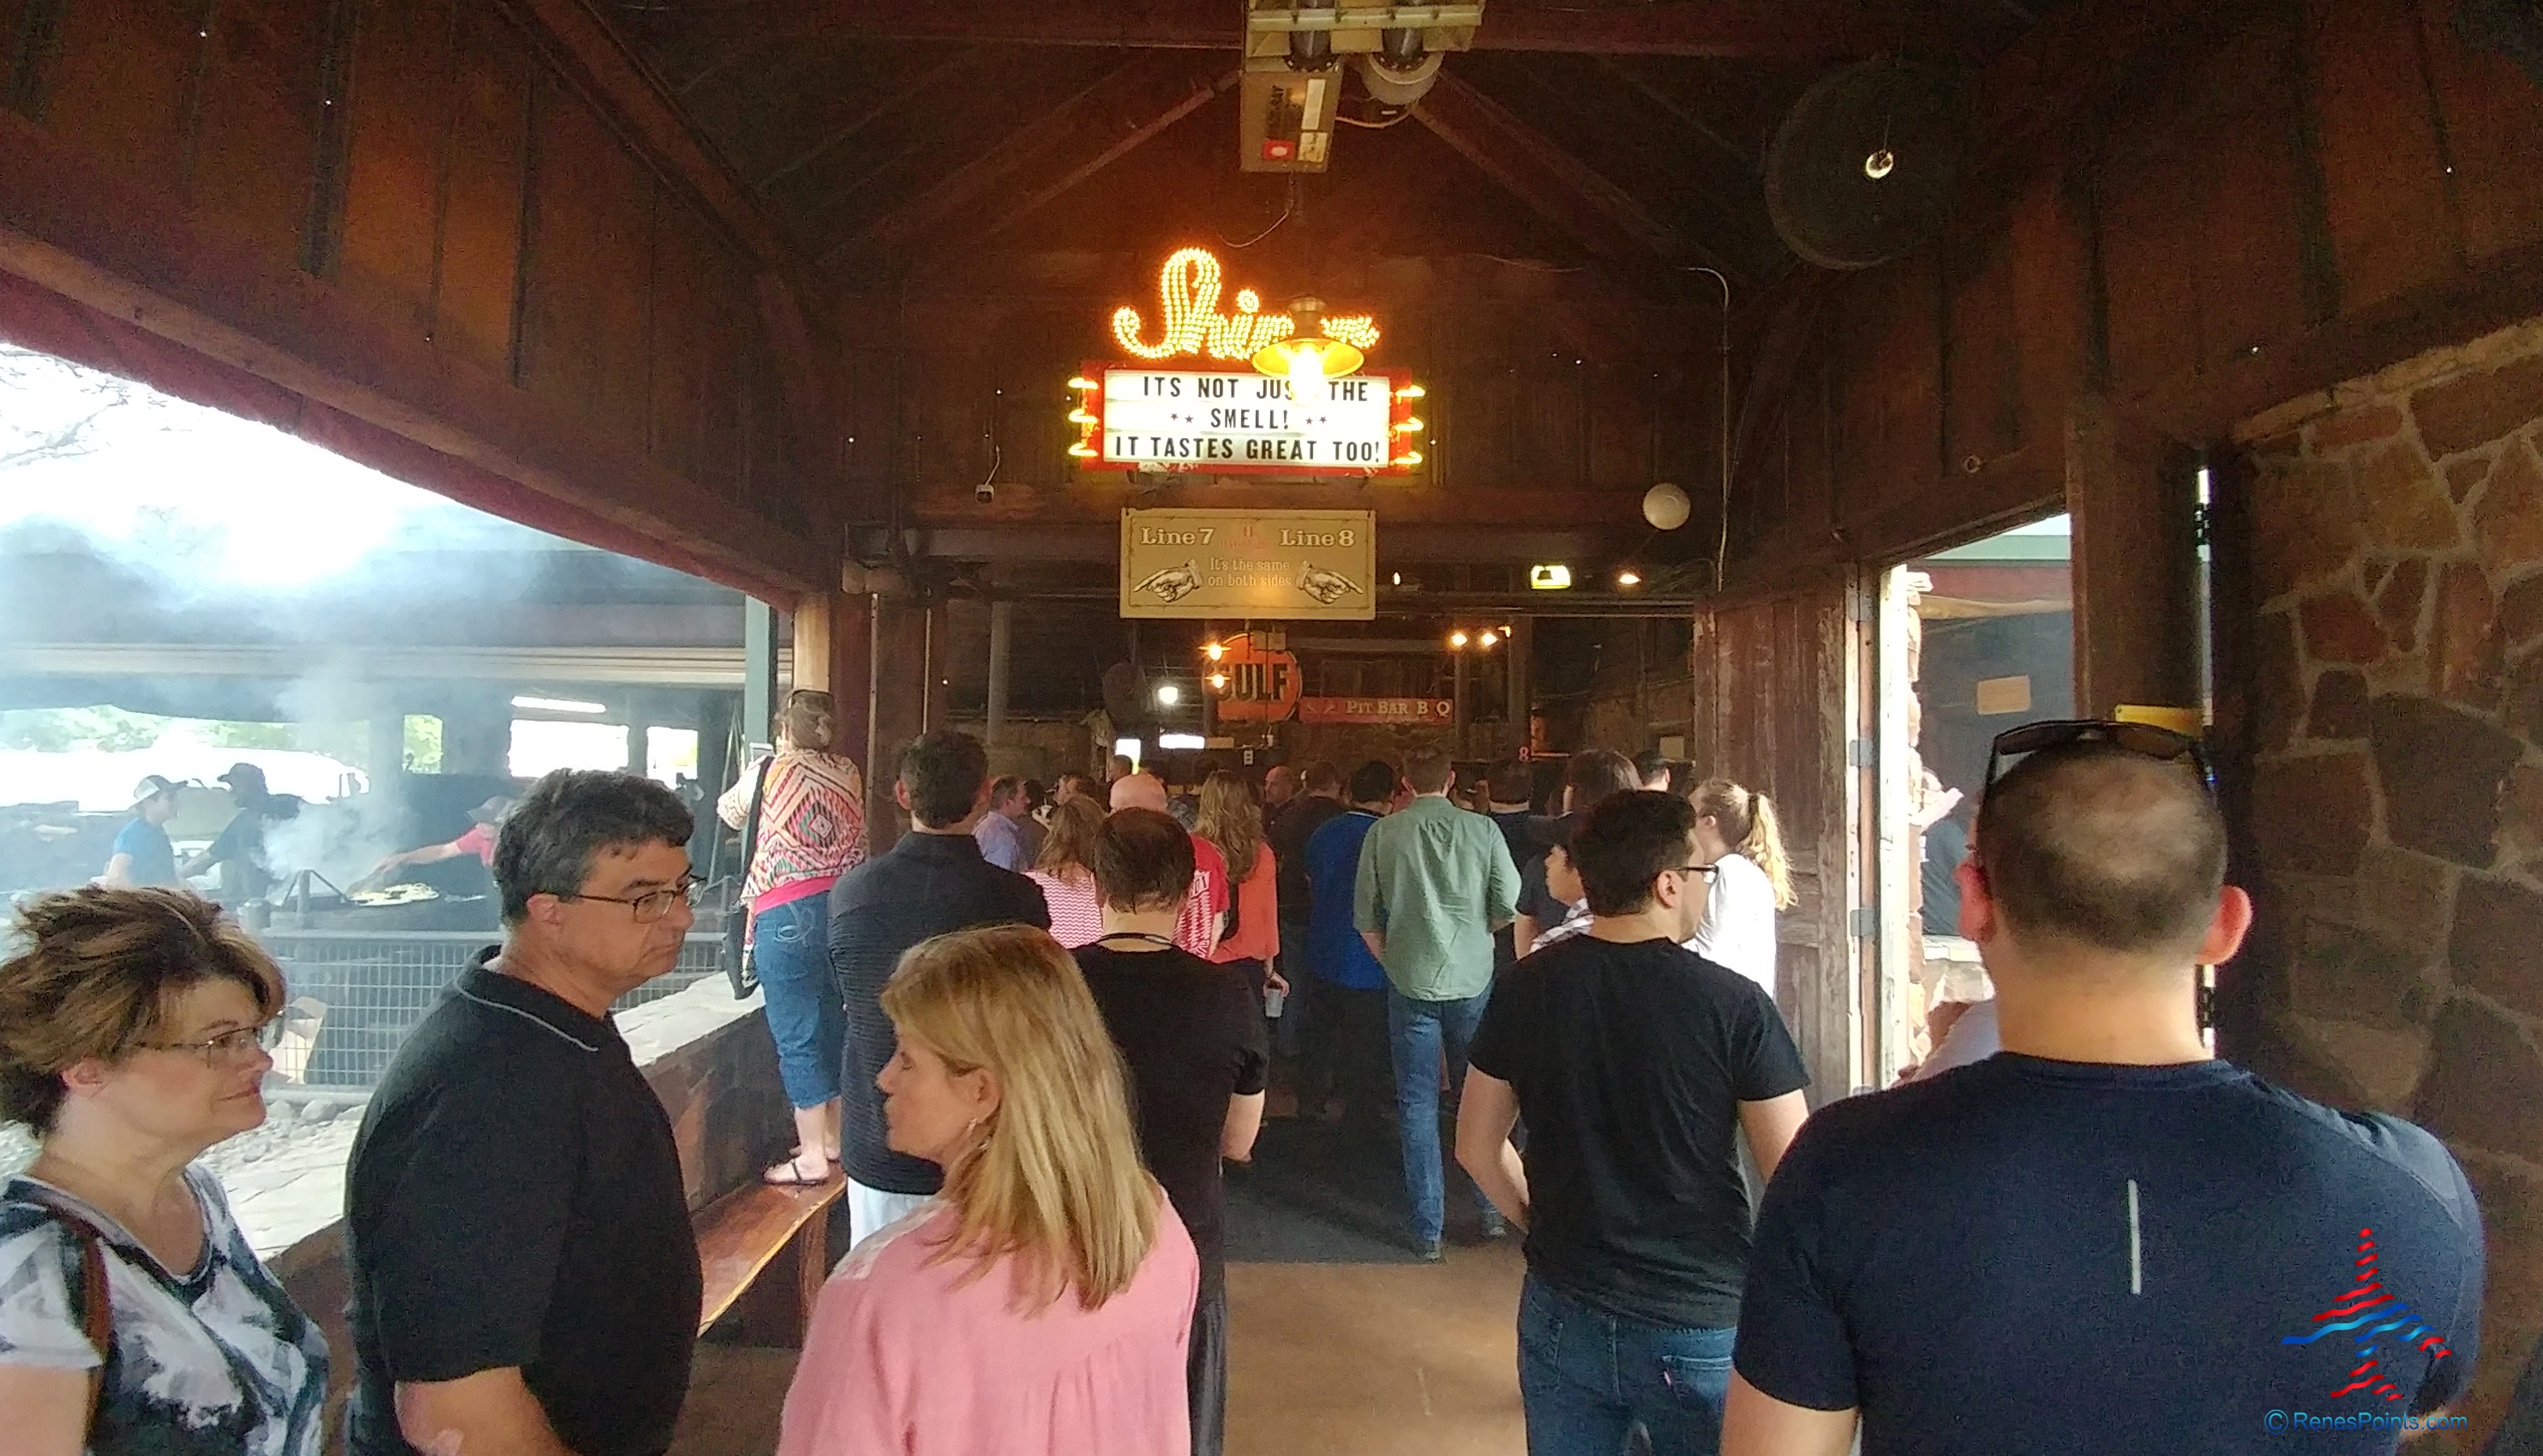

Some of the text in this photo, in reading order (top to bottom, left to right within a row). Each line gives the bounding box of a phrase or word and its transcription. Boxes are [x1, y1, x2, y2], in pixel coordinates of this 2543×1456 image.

[1144, 376, 1368, 401] ITS NOT JUS THE
[1211, 408, 1289, 429] SMELL!
[1116, 436, 1380, 463] IT TASTES GREAT TOO!
[1140, 527, 1196, 545] Line
[1198, 528, 1215, 545] 7
[1279, 529, 1334, 547] Line
[1338, 529, 1355, 547] 8
[1233, 558, 1253, 571] the
[1257, 560, 1290, 572] same
[1208, 573, 1292, 587] on both sides
[1417, 701, 1429, 715] B
[1436, 701, 1450, 717] Q
